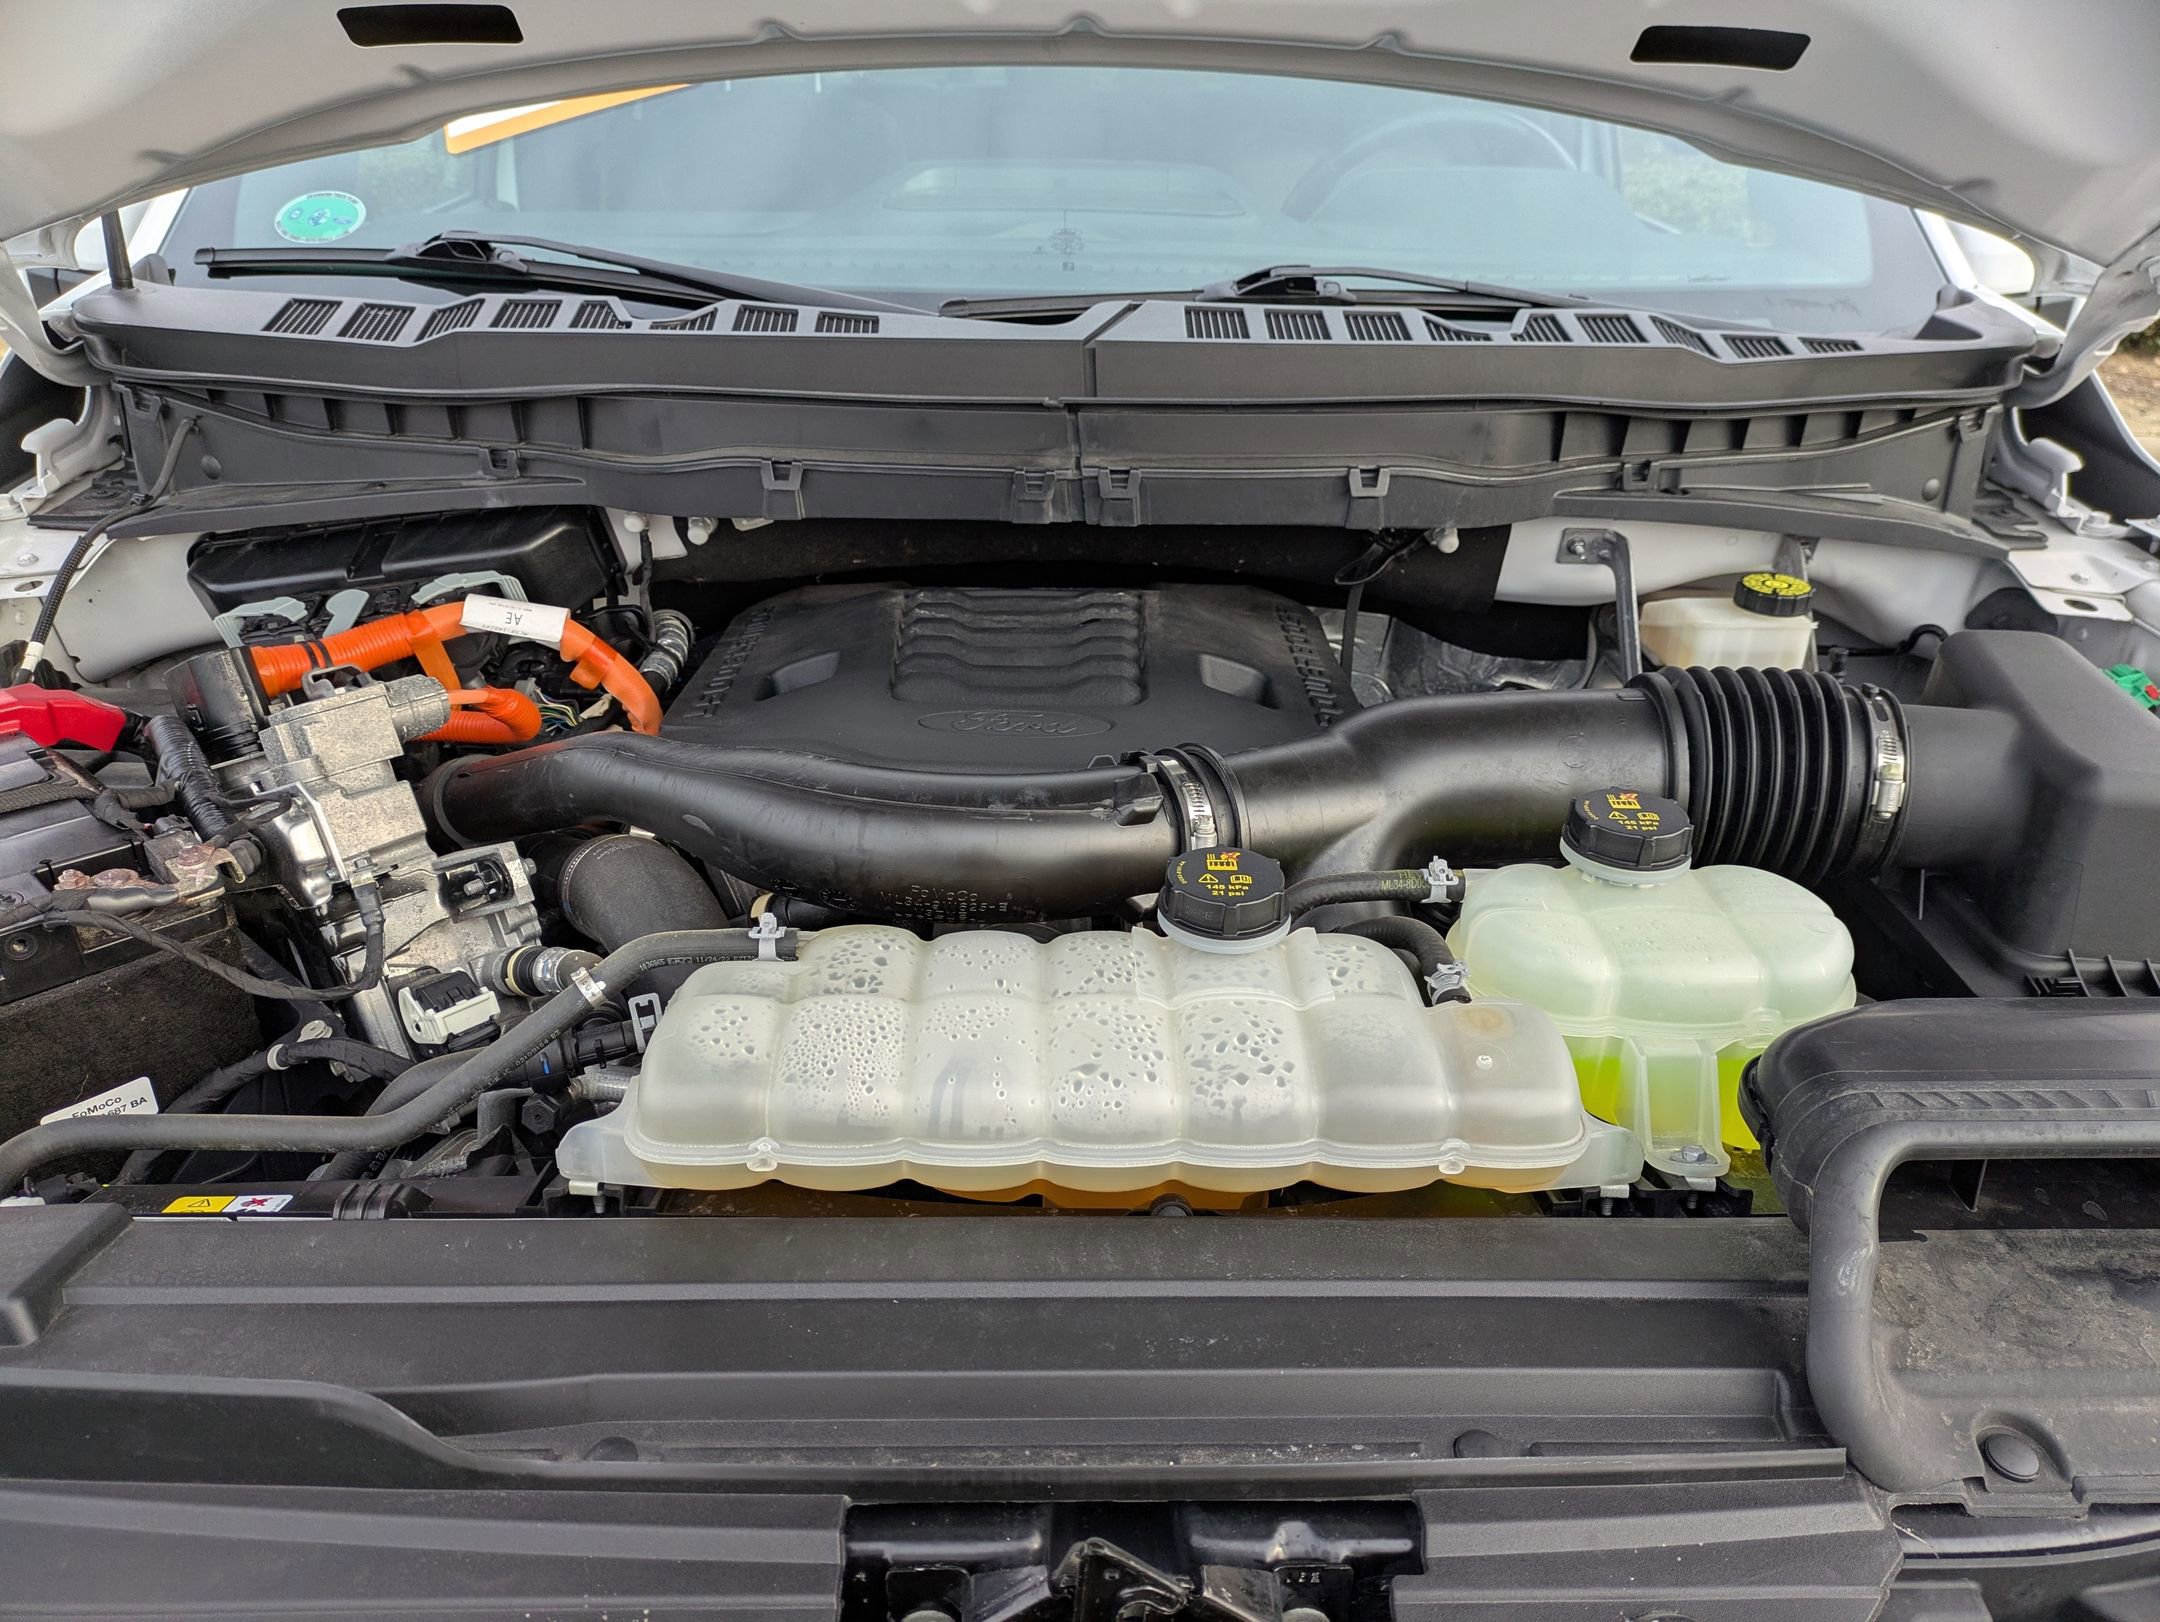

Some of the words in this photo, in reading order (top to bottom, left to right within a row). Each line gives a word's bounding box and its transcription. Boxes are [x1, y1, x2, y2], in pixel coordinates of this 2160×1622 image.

[505, 611, 523, 626] AE
[951, 710, 1078, 735] Ford
[72, 1096, 122, 1119] FoMoCo
[130, 1096, 148, 1109] BA
